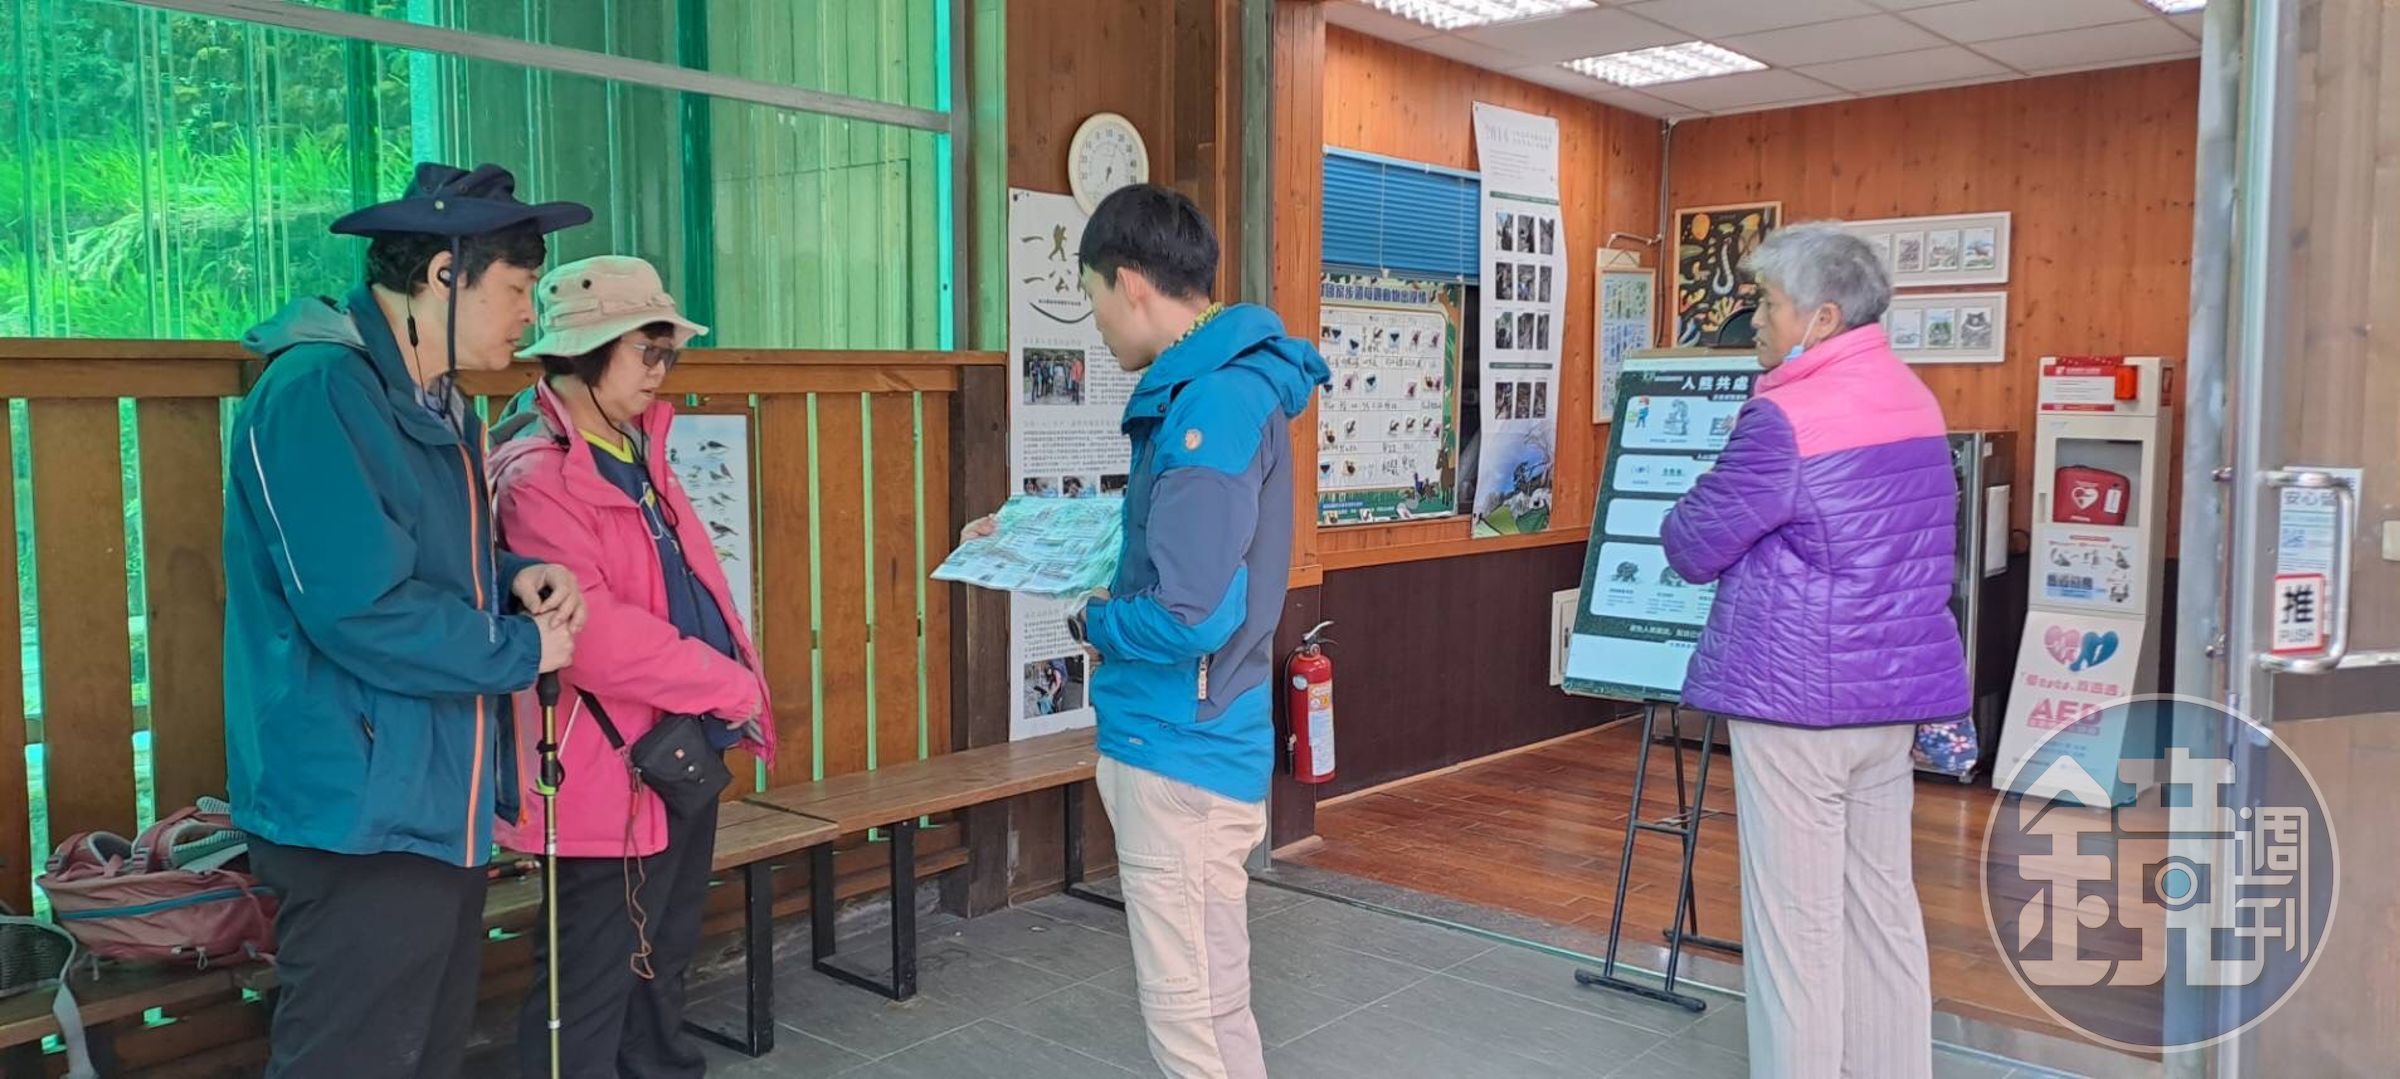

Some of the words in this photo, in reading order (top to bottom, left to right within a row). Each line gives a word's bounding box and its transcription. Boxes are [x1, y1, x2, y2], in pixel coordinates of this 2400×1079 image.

[2282, 585, 2314, 624] 推
[2278, 628, 2314, 643] PUSH
[2027, 697, 2103, 726] AED
